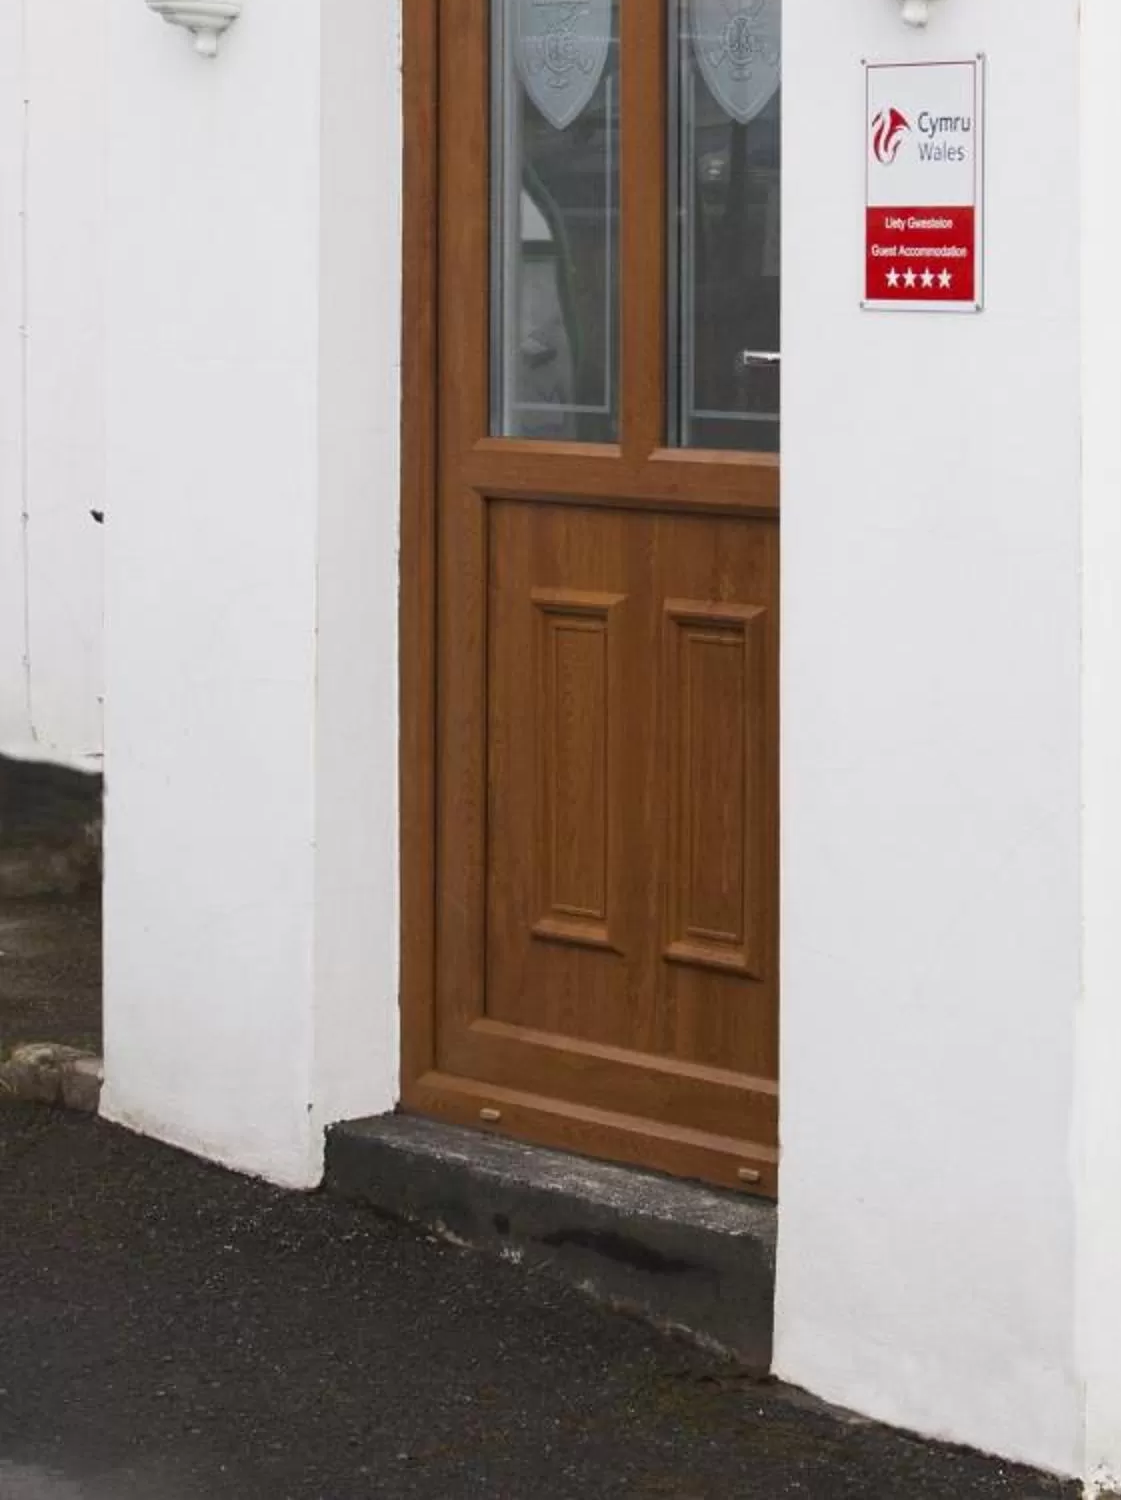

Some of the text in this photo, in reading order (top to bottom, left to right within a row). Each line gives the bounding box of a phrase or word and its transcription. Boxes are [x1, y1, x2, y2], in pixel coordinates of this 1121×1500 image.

[917, 111, 971, 139] Cymru
[919, 141, 966, 161] Wales
[871, 244, 897, 257] Guest
